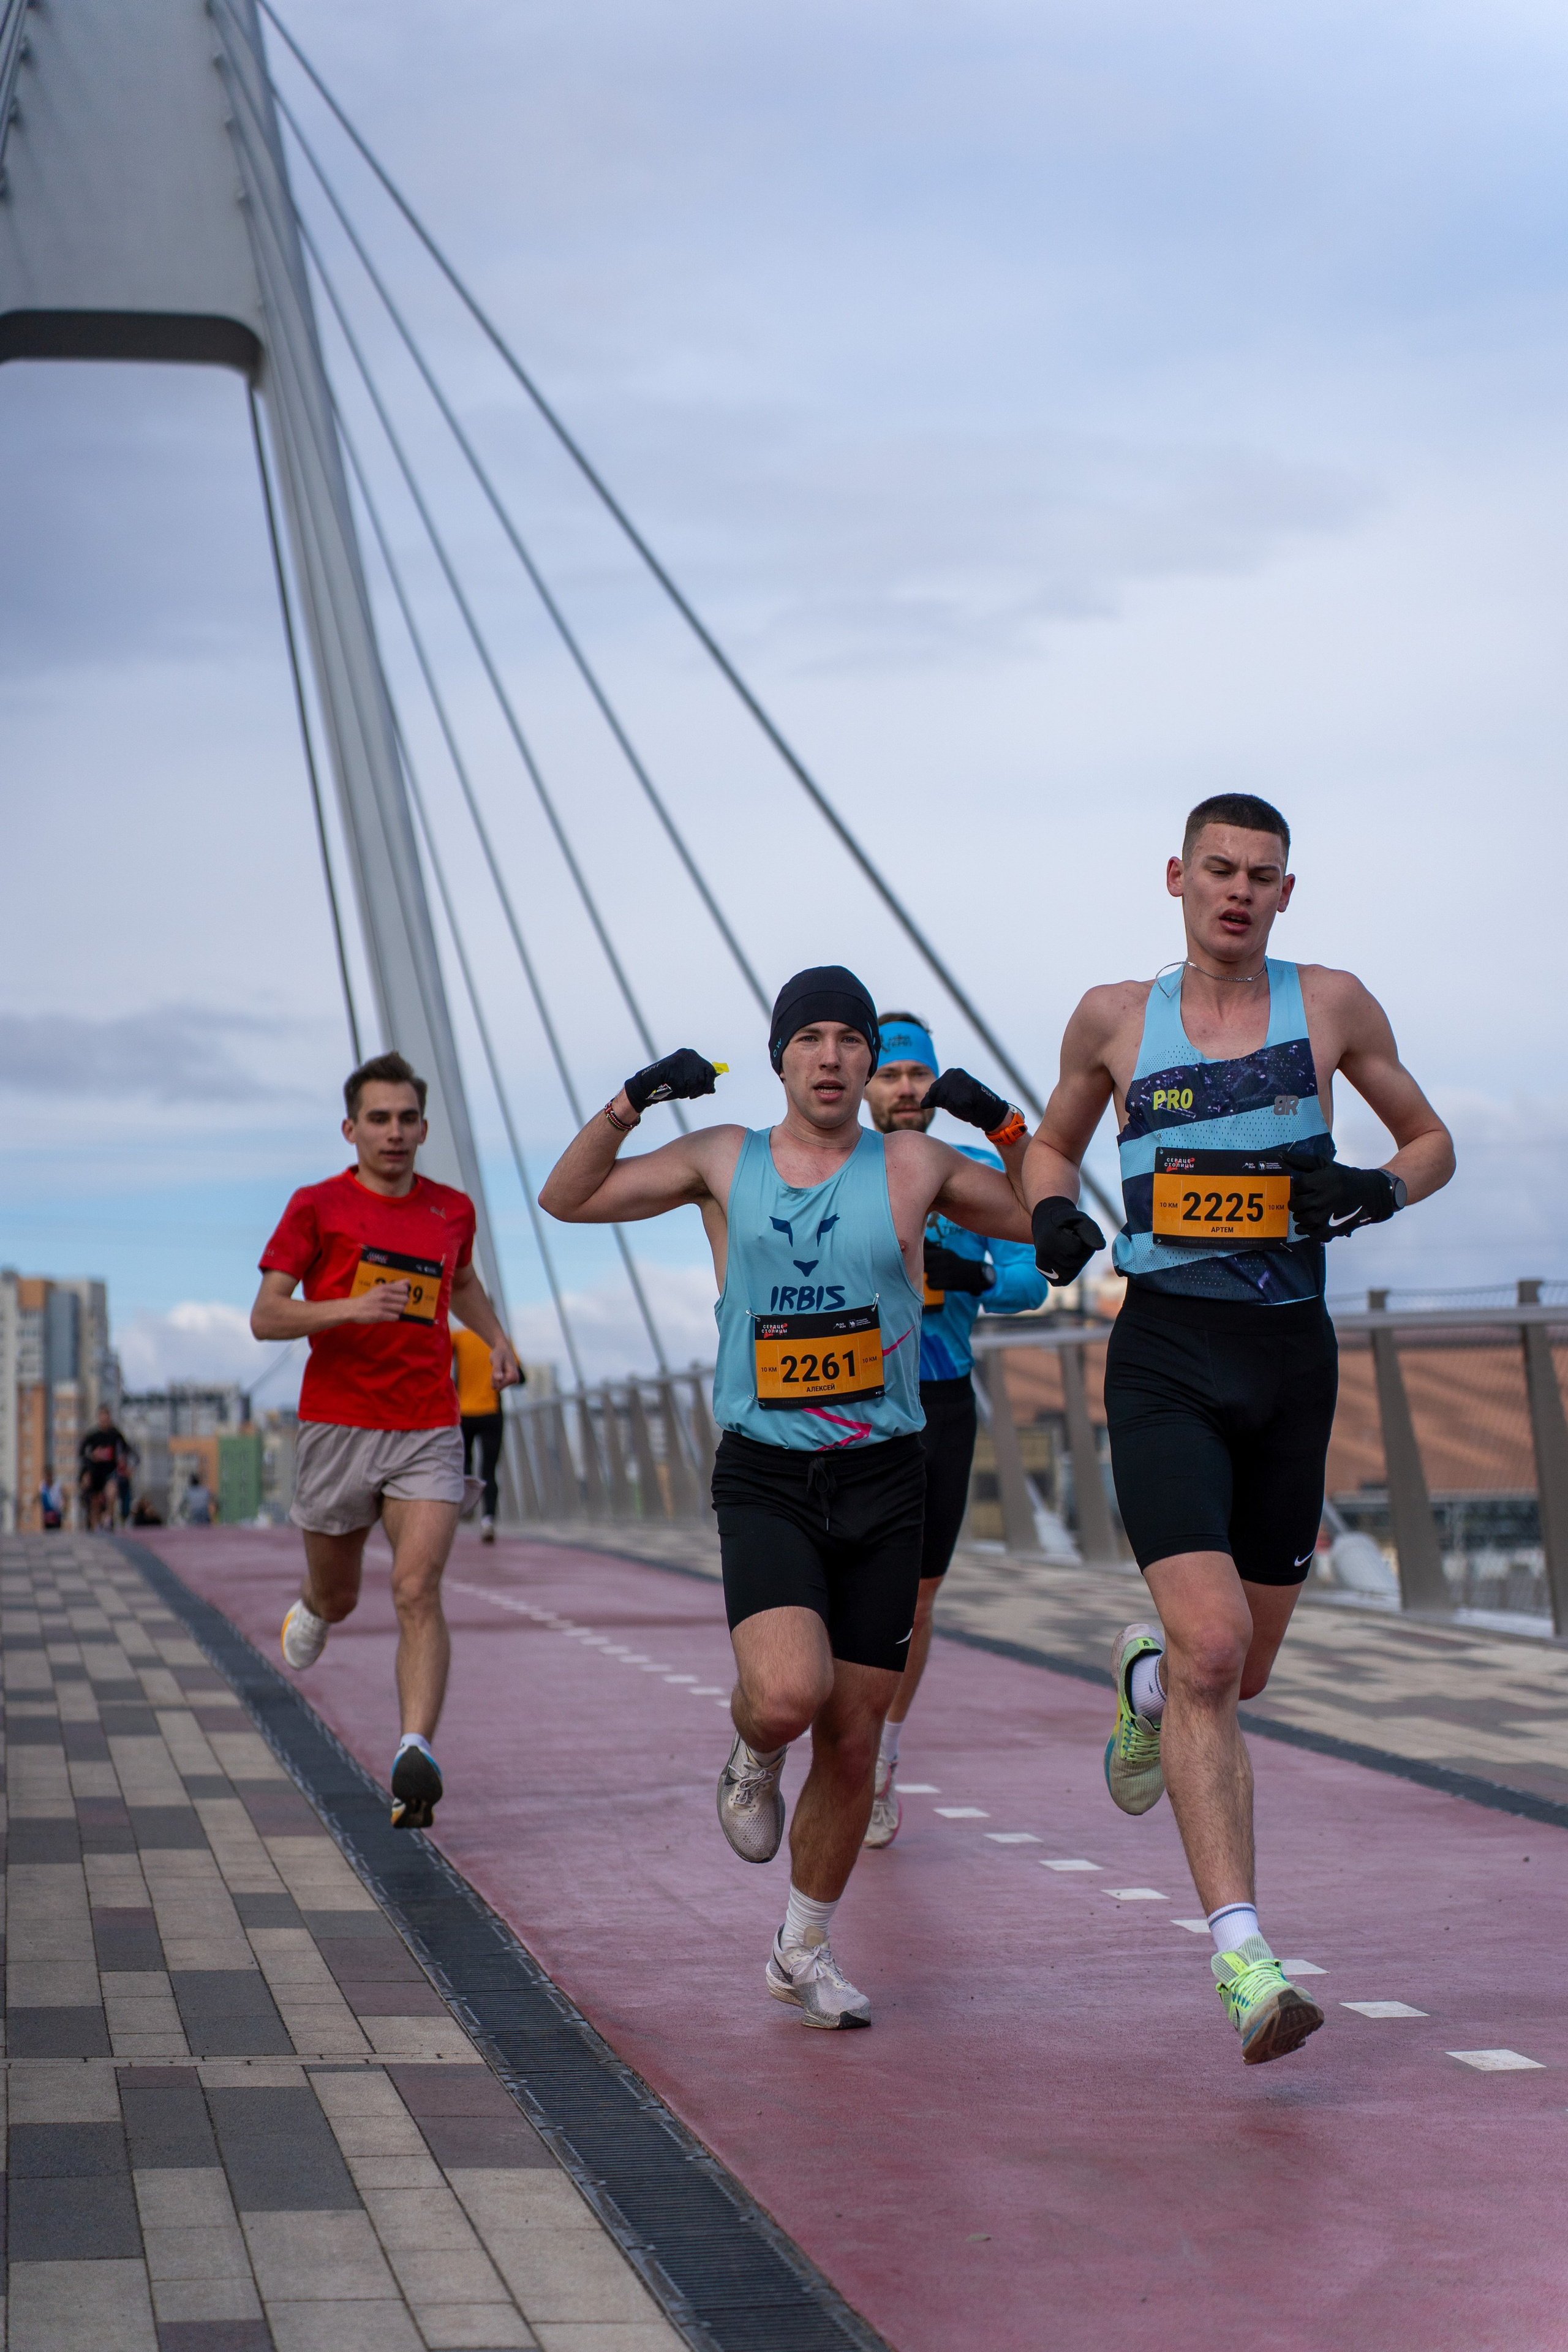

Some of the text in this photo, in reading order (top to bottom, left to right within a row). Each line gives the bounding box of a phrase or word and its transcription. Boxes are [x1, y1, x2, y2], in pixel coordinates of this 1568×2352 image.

[1153, 1088, 1193, 1110] PRO
[1182, 1191, 1264, 1222] 2225
[771, 1286, 845, 1311] IRBIS
[781, 1350, 856, 1383] 2261
[806, 1383, 835, 1393] АЛЕКСЕЙ
